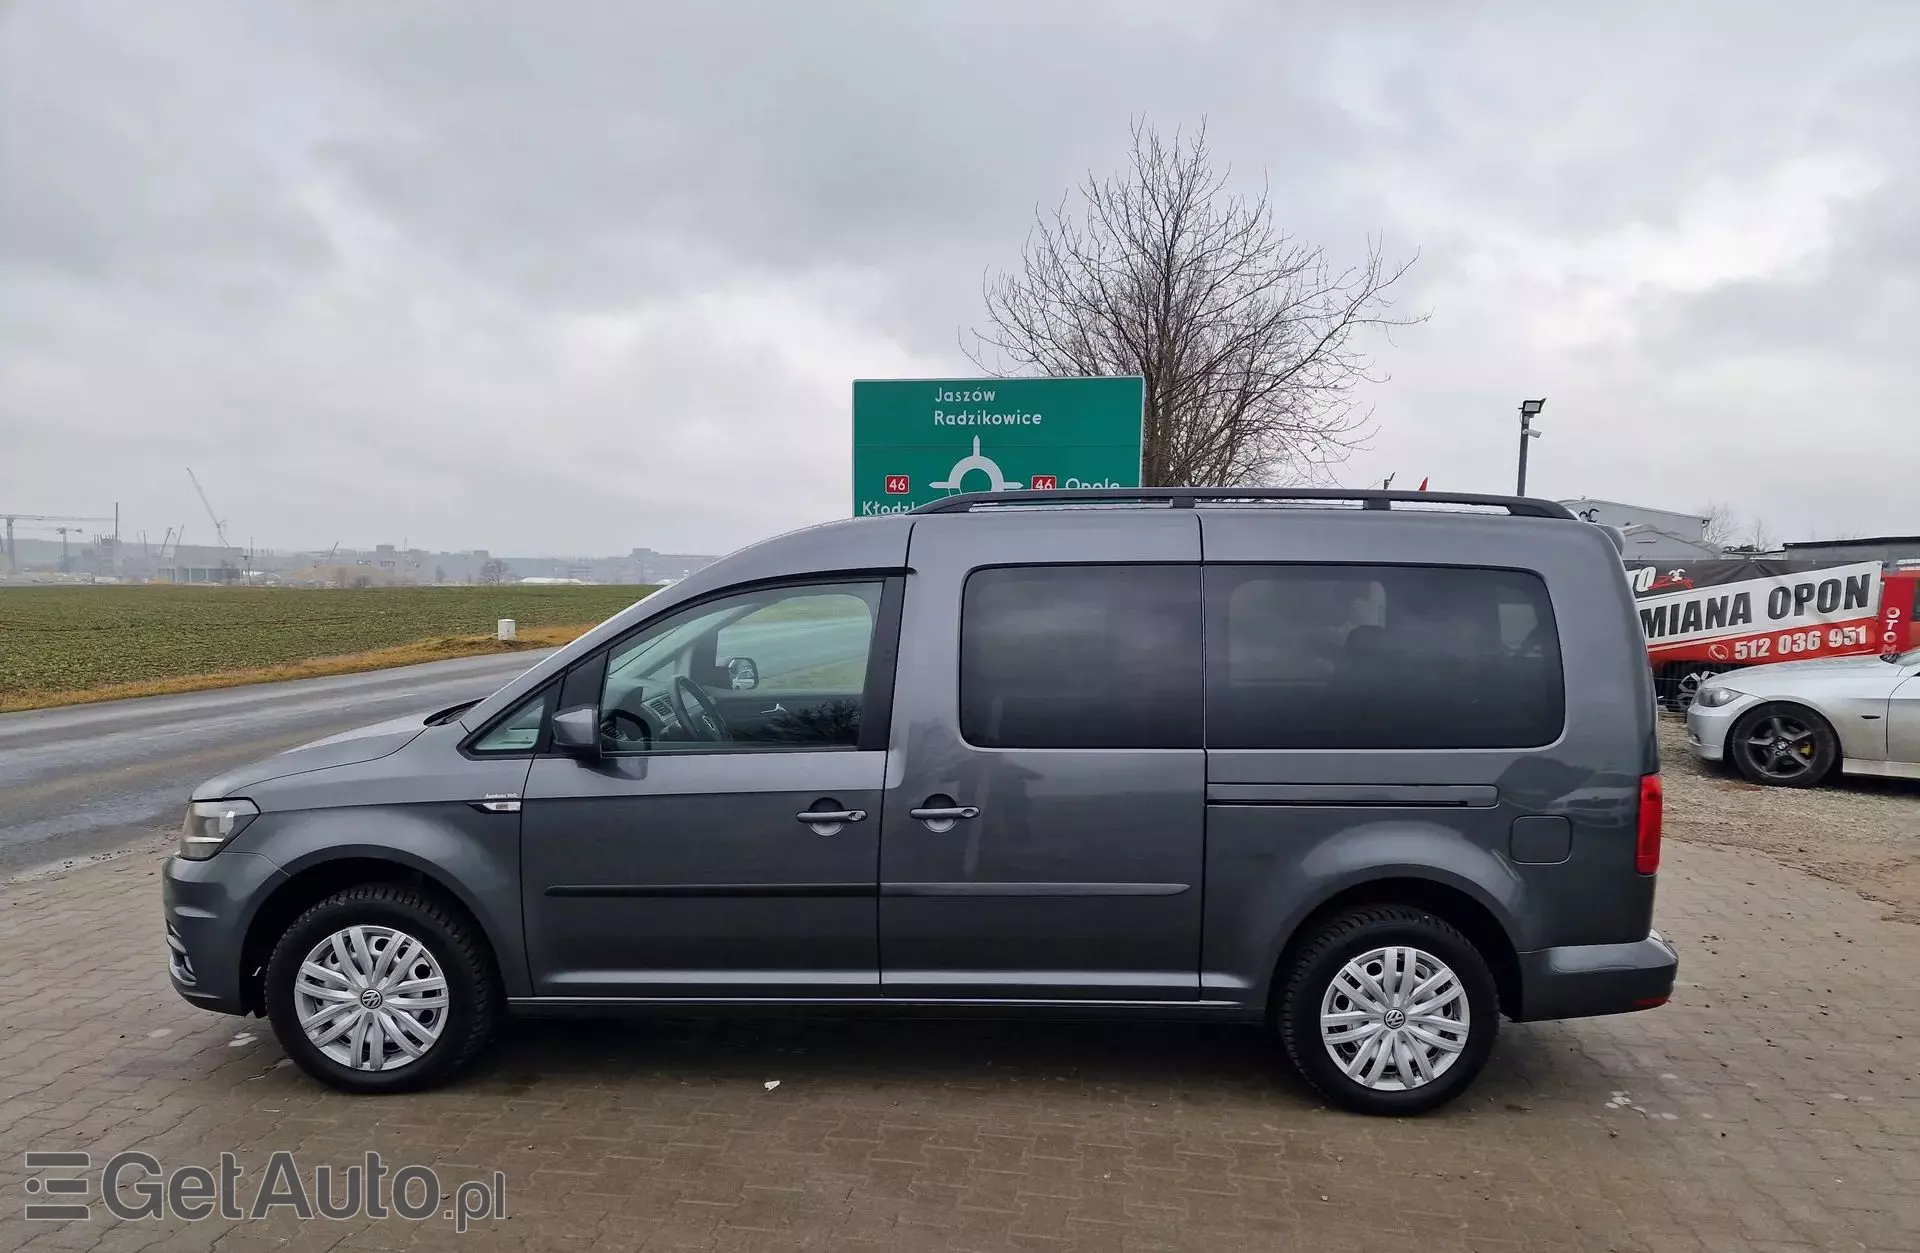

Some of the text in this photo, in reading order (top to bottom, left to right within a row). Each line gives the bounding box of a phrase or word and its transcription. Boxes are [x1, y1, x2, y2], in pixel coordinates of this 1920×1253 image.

[935, 387, 996, 402] Jaszów
[934, 410, 1042, 426] Radzikowice
[889, 479, 906, 491] 46
[1035, 478, 1053, 490] 46
[1767, 573, 1871, 620] OPON
[1734, 625, 1867, 660] 512 036 951
